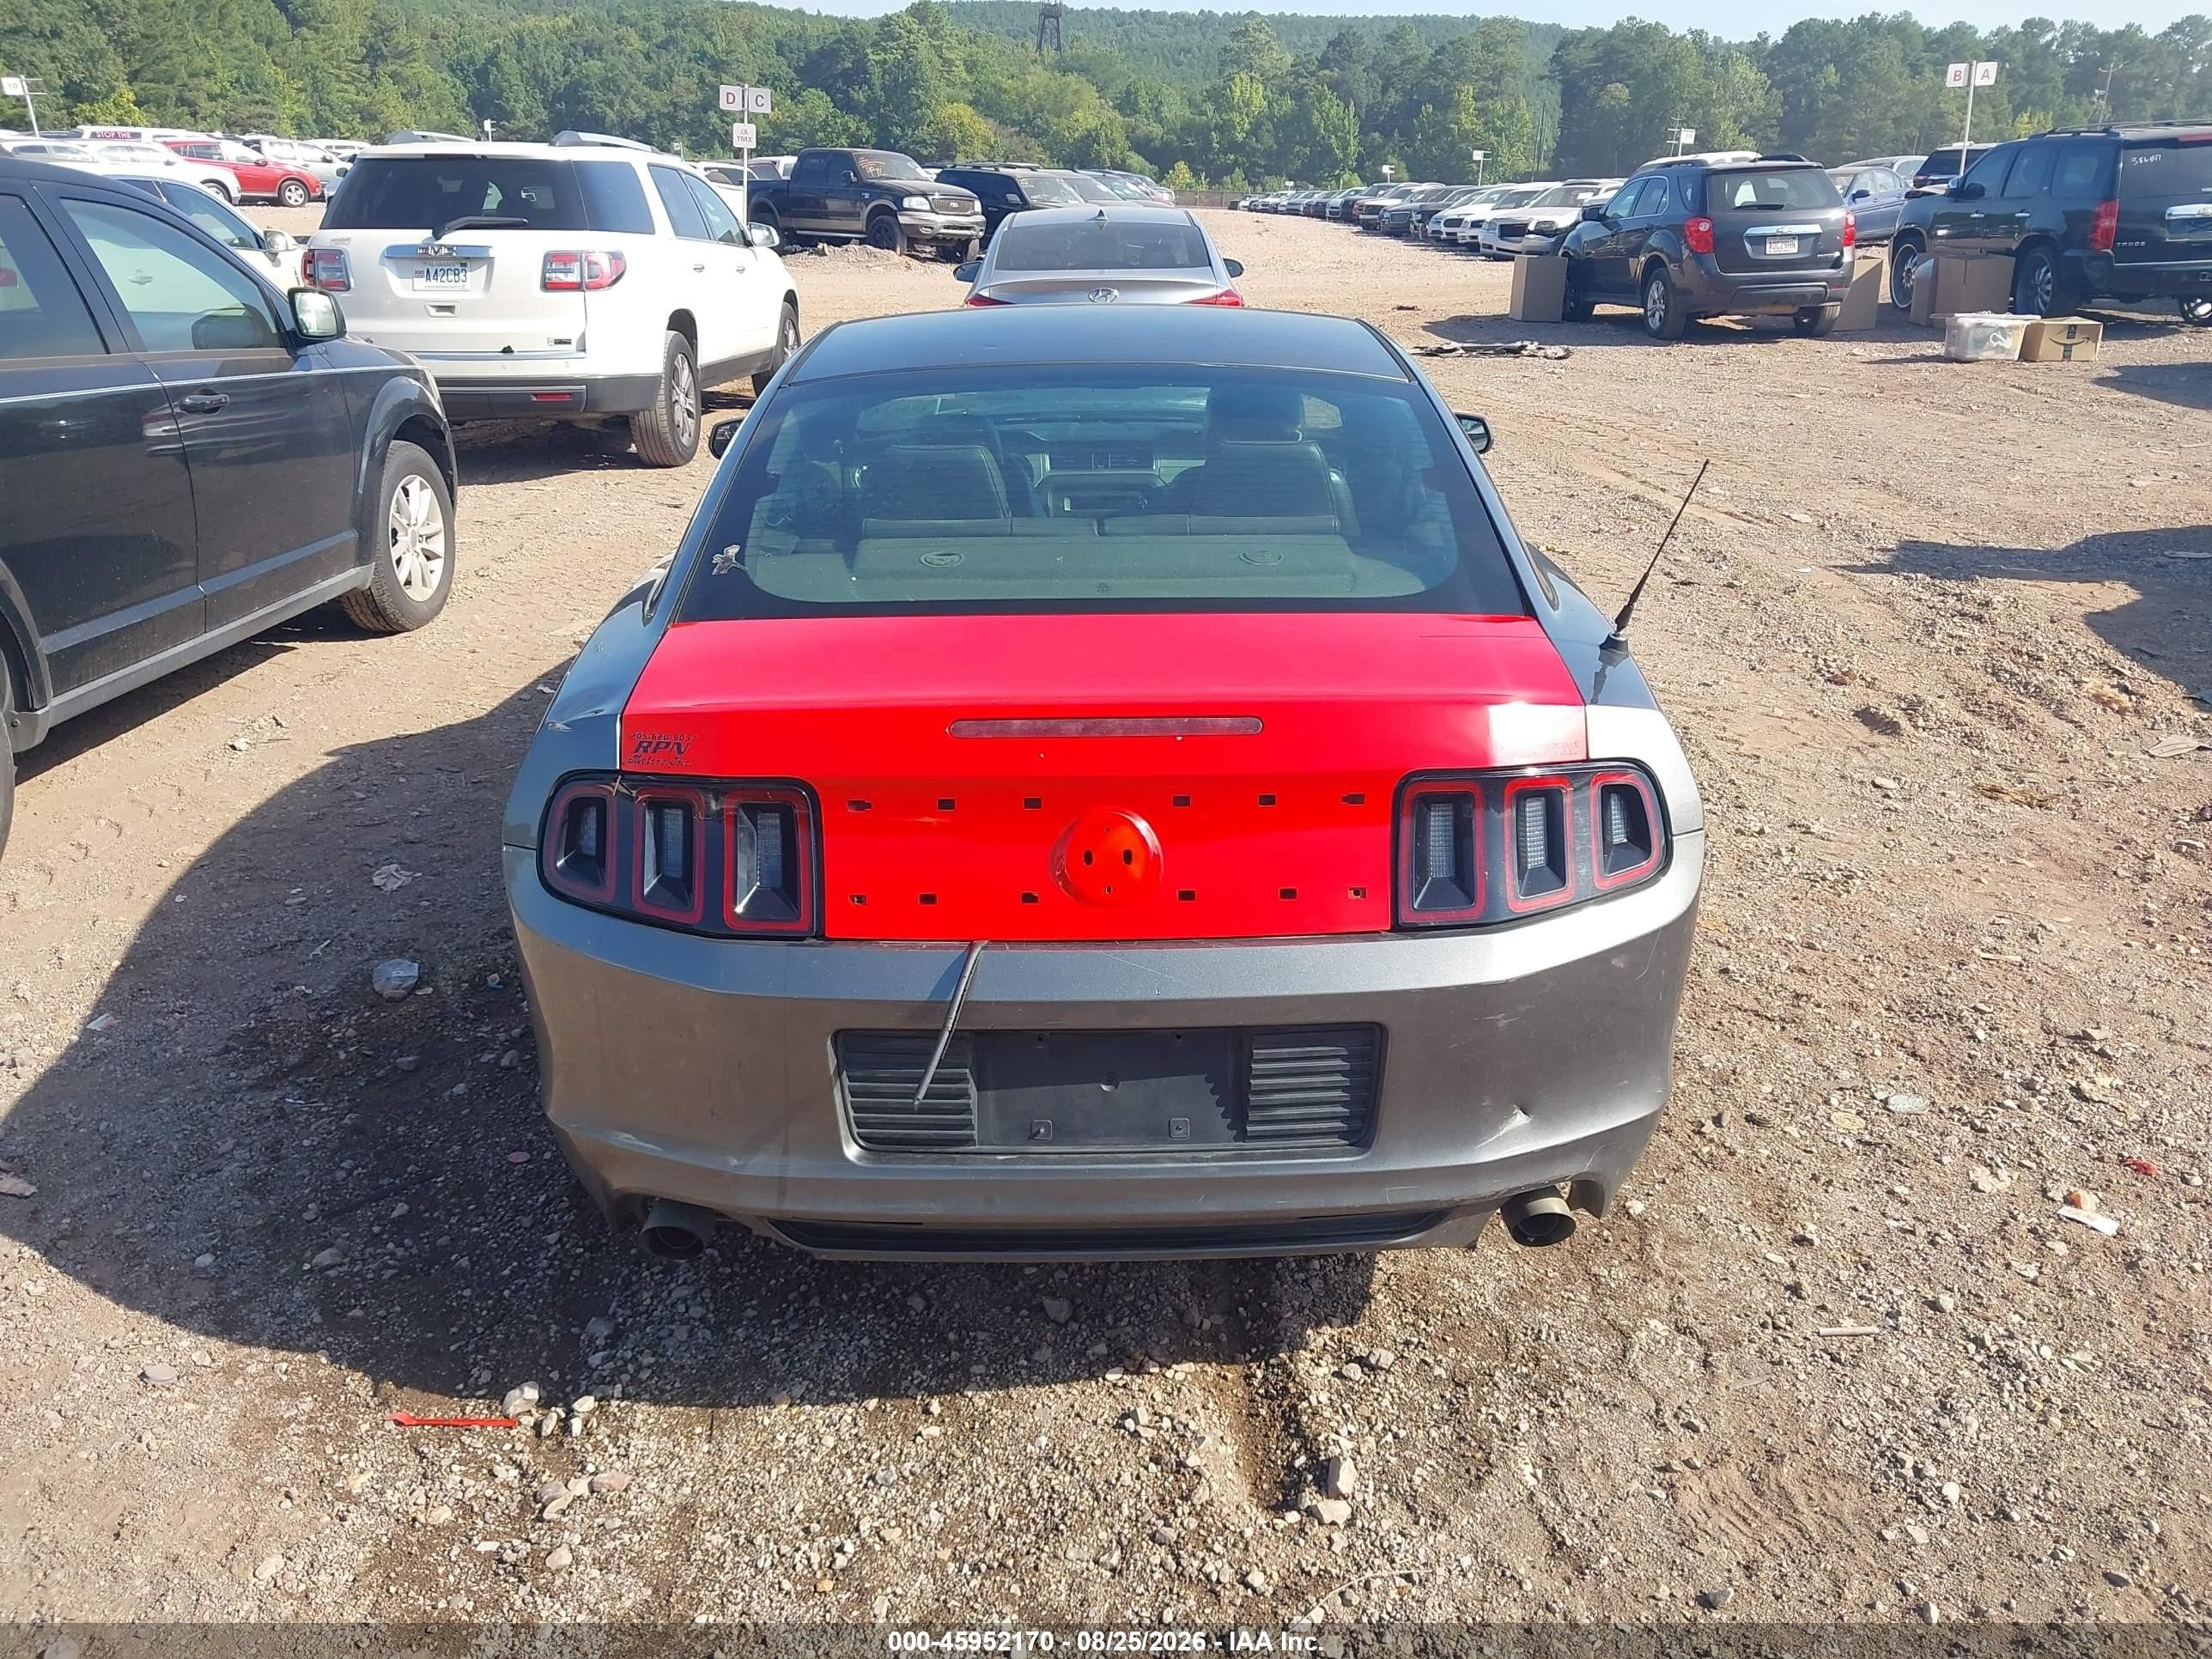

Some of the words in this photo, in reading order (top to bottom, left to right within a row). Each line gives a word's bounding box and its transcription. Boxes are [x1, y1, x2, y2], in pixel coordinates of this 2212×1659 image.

[1953, 70, 1962, 82] B
[1980, 68, 1990, 80] A
[726, 91, 736, 105] D
[755, 94, 764, 107] C
[417, 245, 458, 257] GMC
[425, 267, 468, 283] A42CB3
[633, 740, 690, 756] RPN
